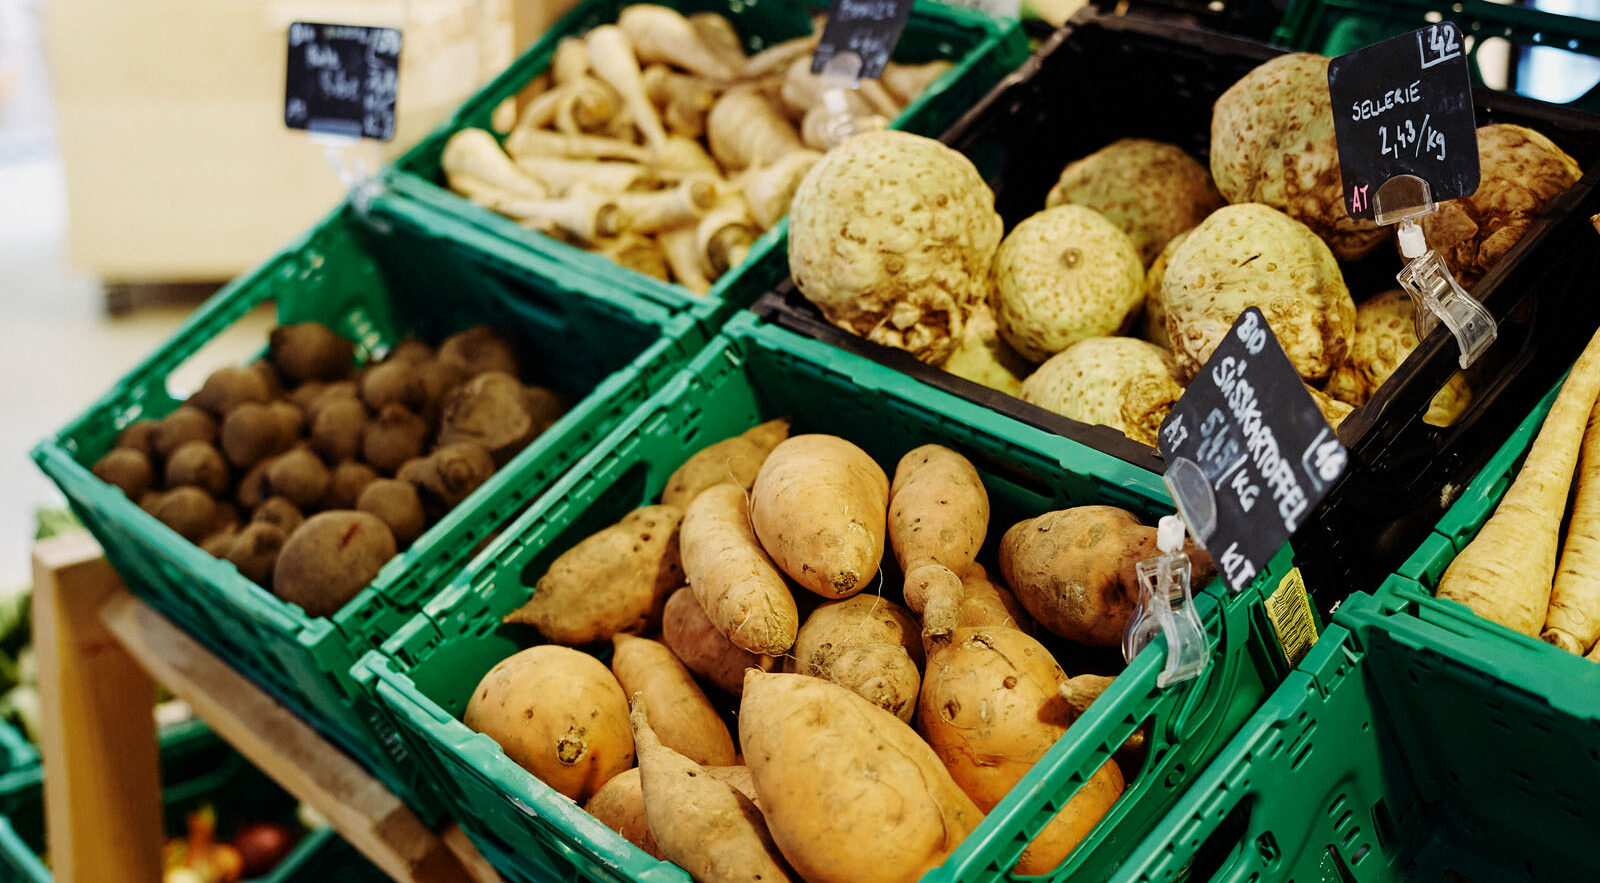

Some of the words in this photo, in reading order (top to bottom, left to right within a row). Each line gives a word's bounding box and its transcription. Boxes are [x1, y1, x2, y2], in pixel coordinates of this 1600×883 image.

[1427, 24, 1460, 58] 42
[1351, 79, 1421, 121] SELLERIE
[1352, 184, 1369, 213] AT
[1236, 311, 1267, 355] BIO
[1163, 414, 1189, 454] AT
[1314, 439, 1348, 481] 46
